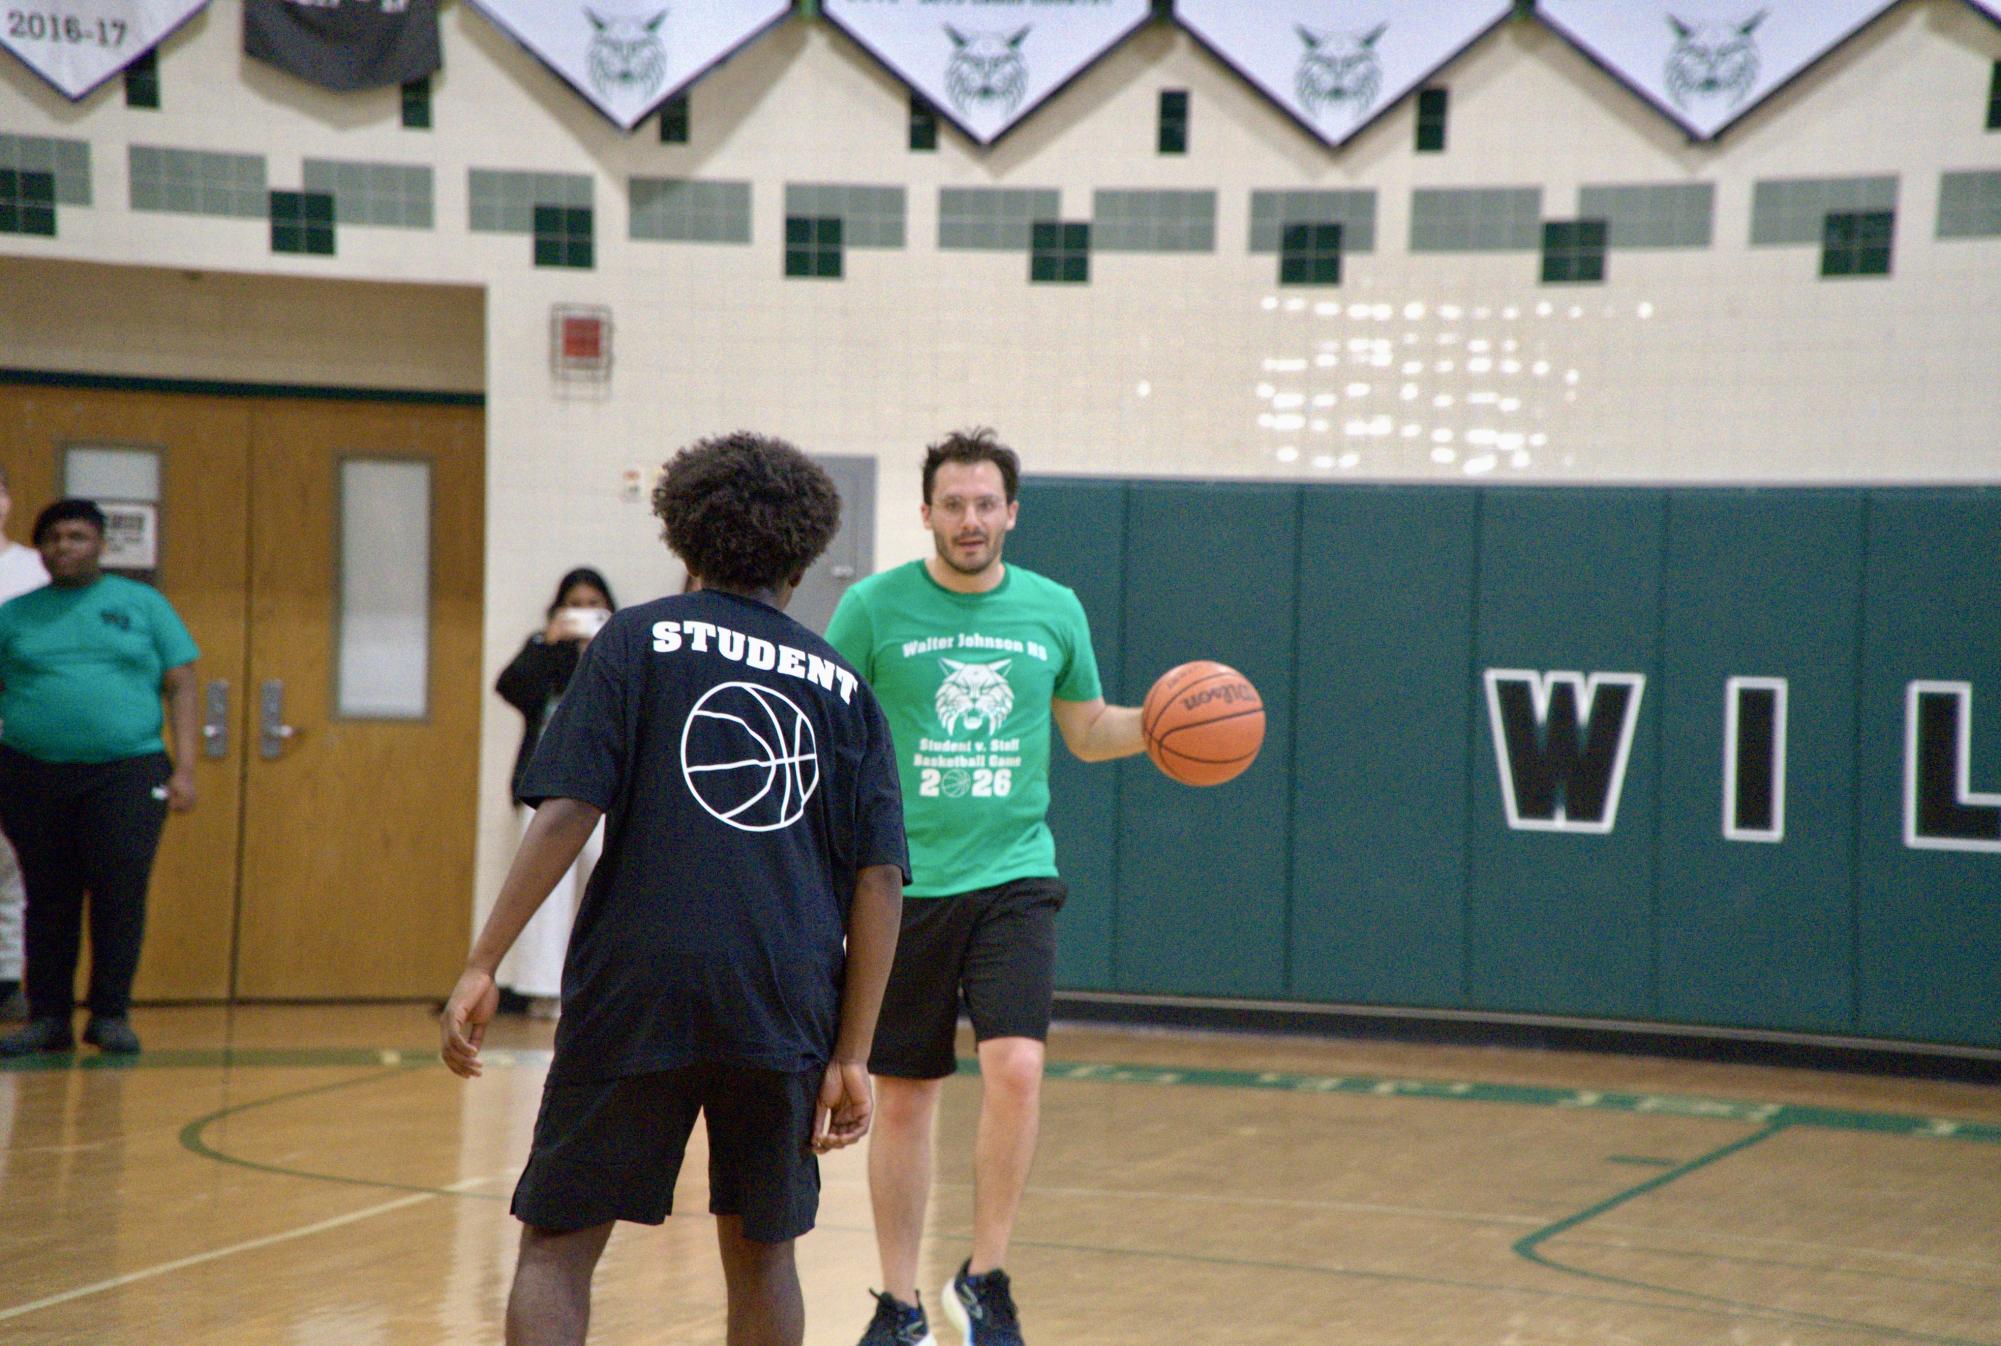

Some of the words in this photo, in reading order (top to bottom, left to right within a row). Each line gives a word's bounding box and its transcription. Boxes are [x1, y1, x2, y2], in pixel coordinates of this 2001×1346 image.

[7, 9, 127, 47] 2016-17
[902, 636, 955, 658] Walter
[957, 632, 1024, 652] Johnson
[651, 620, 859, 705] STUDENT
[919, 738, 972, 752] Student
[990, 738, 1020, 752] Staff
[913, 753, 985, 768] Basketball
[989, 754, 1022, 768] Game
